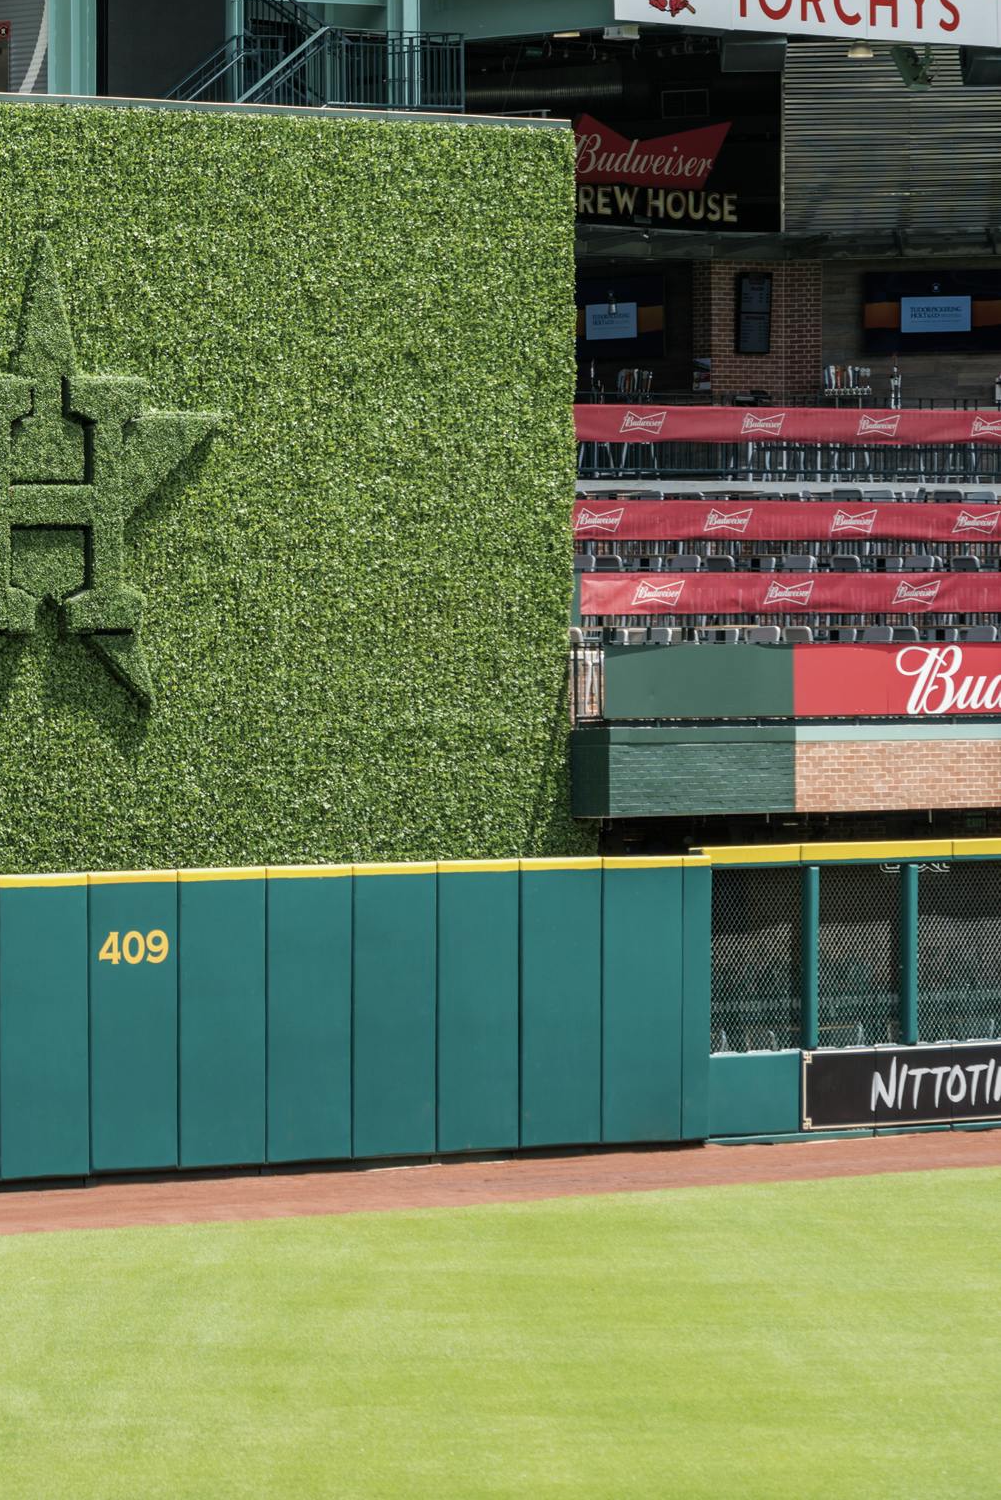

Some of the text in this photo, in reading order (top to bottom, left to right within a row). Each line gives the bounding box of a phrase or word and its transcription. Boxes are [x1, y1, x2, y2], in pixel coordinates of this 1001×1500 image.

[575, 133, 713, 178] Budweiser
[577, 184, 739, 223] REW HOUSE
[974, 420, 1001, 432] Budwei
[635, 585, 680, 599] Budweiser
[767, 585, 810, 599] Budweiser
[98, 928, 169, 965] 409
[870, 1056, 1001, 1112] NITTOTI
